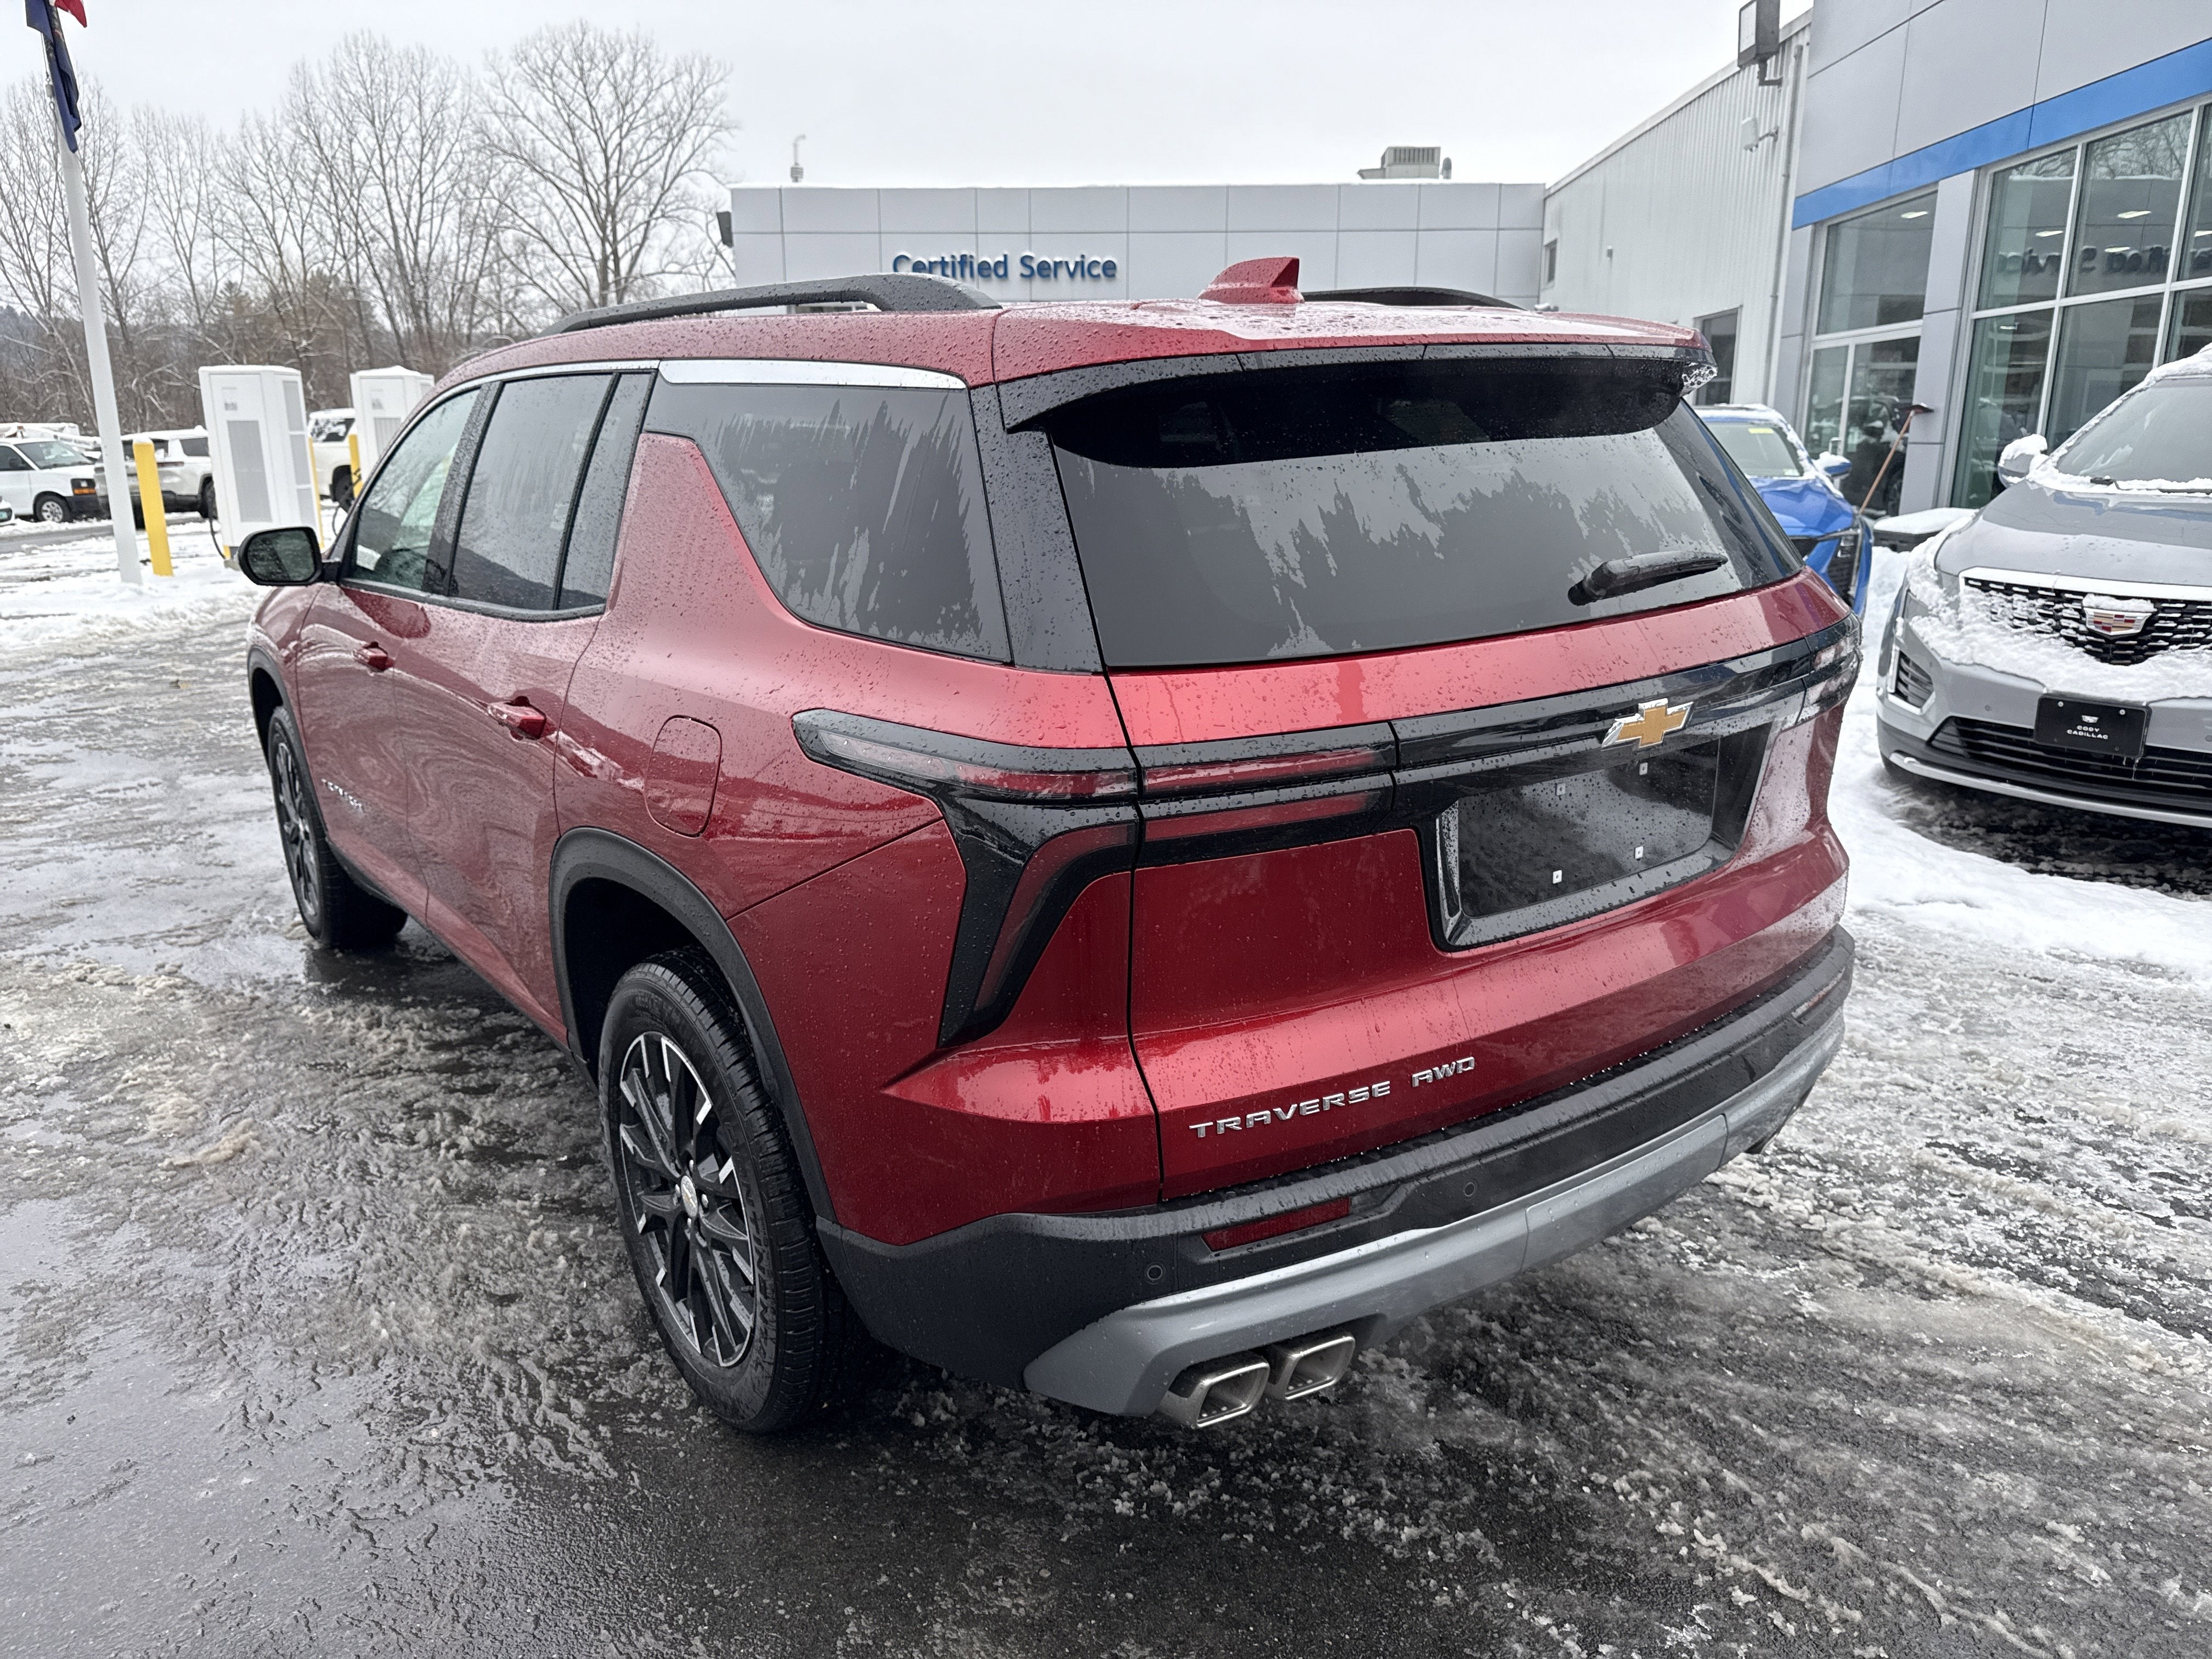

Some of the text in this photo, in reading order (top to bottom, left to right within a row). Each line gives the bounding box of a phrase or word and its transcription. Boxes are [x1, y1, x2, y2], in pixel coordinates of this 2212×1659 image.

[893, 253, 1117, 279] Certified Service
[2067, 730, 2108, 740] CADILLAC
[1189, 1056, 1475, 1138] TRAVERSE AWD
